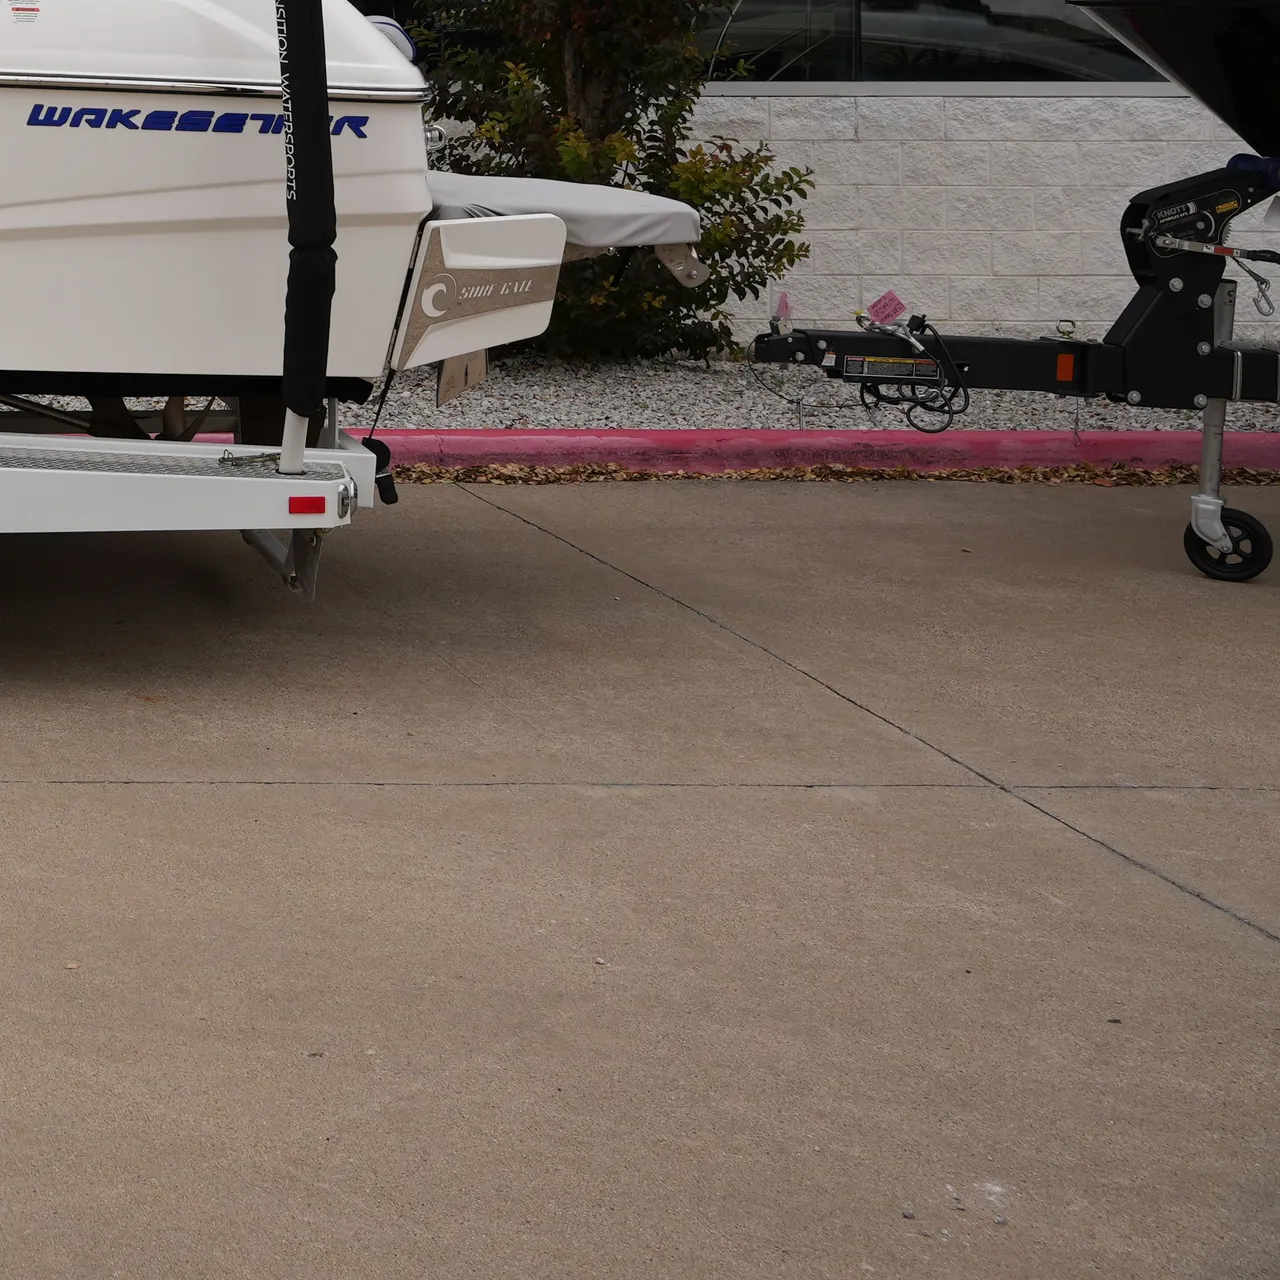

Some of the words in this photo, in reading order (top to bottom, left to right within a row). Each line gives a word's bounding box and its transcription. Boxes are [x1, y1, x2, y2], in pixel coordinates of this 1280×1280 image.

[26, 103, 370, 139] WAKESETR
[280, 72, 297, 201] WATERSPORTS
[1156, 203, 1187, 219] KNOTT
[458, 283, 498, 300] SURF
[500, 279, 536, 295] GATE
